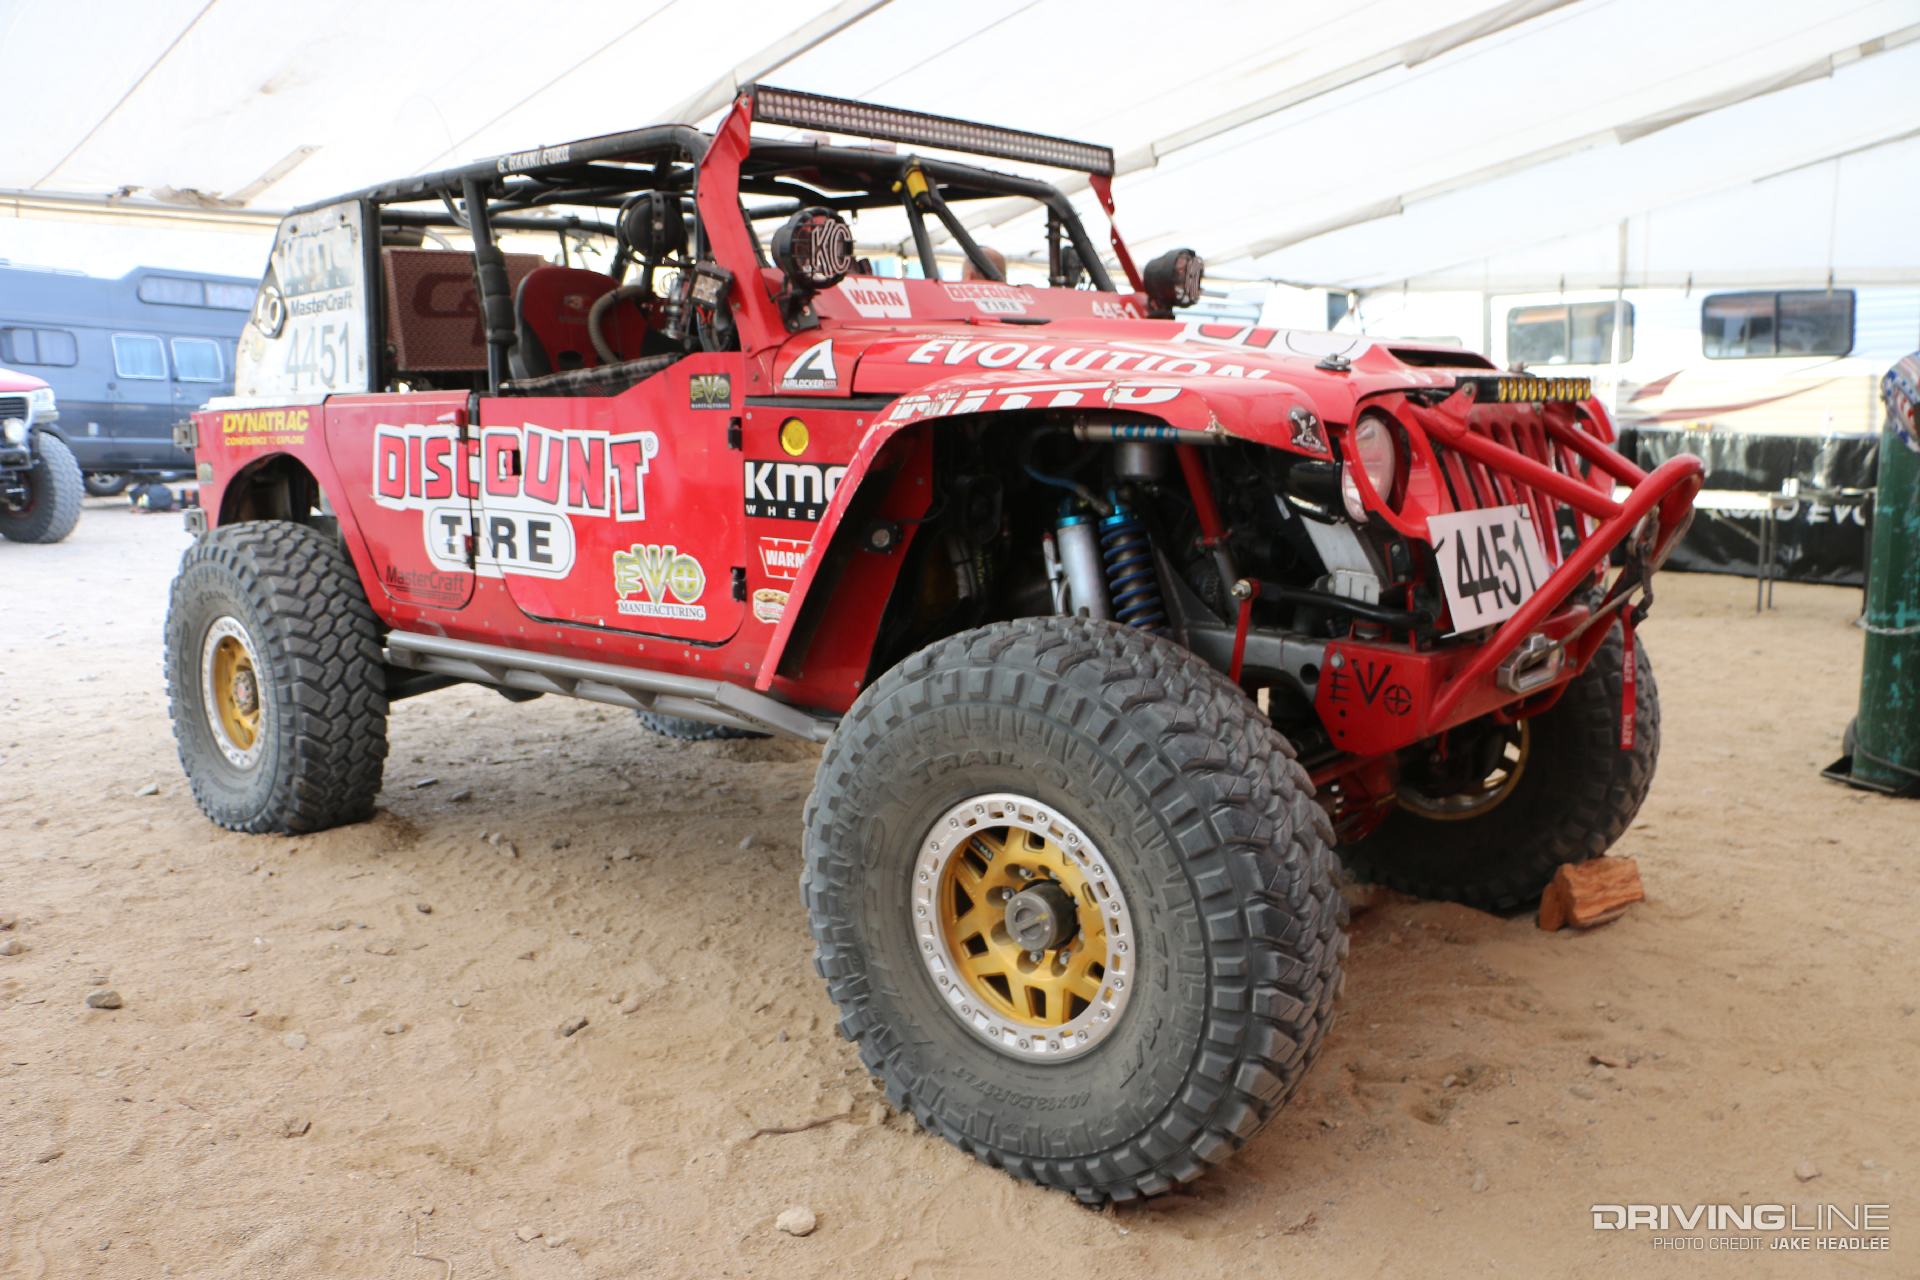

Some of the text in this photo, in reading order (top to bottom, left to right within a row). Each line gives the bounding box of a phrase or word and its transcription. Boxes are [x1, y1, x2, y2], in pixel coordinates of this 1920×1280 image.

[812, 219, 851, 278] KC
[291, 293, 353, 317] MasterCraft
[850, 288, 904, 306] WARN
[981, 300, 1019, 312] TIRE
[1091, 300, 1140, 319] 4451
[286, 321, 350, 389] 4451
[907, 338, 1271, 380] EVOLUTION
[223, 409, 309, 433] DYNATRAC
[1114, 425, 1177, 438] KING
[377, 428, 645, 515] DISCOUNT
[440, 514, 553, 565] TIRE
[765, 549, 807, 569] WARN
[1456, 519, 1537, 615] 4451
[385, 564, 465, 592] MasterCraft
[614, 544, 706, 605] EVO
[618, 601, 705, 619] MANUFACTURING
[908, 749, 1024, 785] TRAIL
